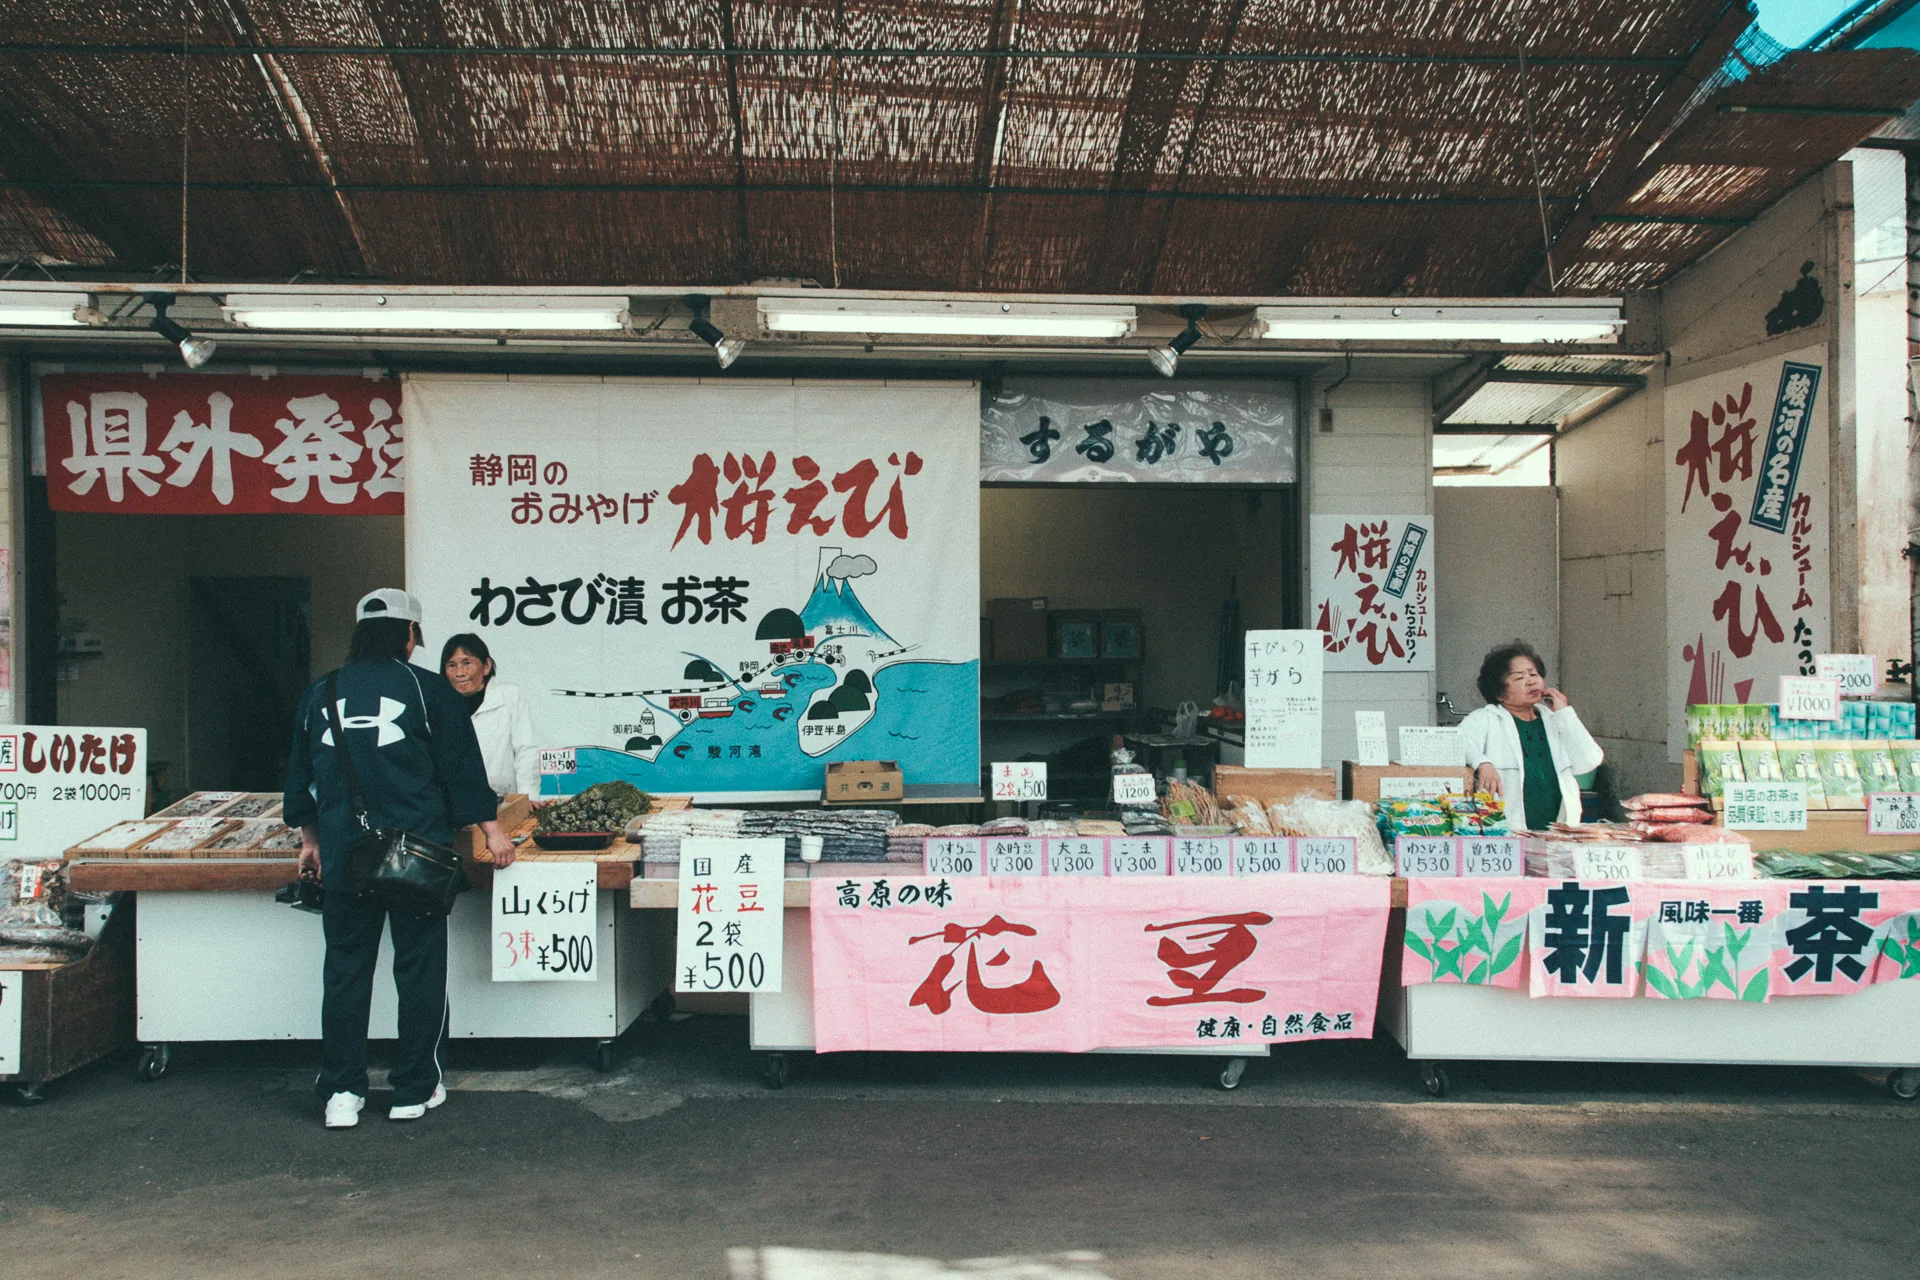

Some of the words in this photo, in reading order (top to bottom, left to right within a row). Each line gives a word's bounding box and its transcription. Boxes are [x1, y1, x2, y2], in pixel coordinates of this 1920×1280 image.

[1019, 416, 1234, 466] するがや
[1757, 373, 1811, 521] 駿河の名産
[469, 453, 568, 487] 静岡の
[510, 489, 660, 525] おみやげ
[667, 451, 924, 552] 桜えび
[1676, 382, 1784, 658] 桜えび
[470, 572, 648, 627] わさび漬
[661, 576, 750, 625] お茶
[1331, 520, 1406, 665] 桜えび
[1416, 568, 1428, 638] カルシューム
[825, 624, 858, 635] 富士川
[740, 661, 760, 672] 静岡
[802, 724, 846, 736] 伊豆半島
[22, 732, 137, 775] しいたけ
[707, 745, 761, 758] 駿河湾
[1734, 788, 1799, 802] 当店のお茶は
[1058, 842, 1091, 855] 大豆
[693, 853, 755, 876] 国産
[930, 857, 973, 873] ¥300
[991, 856, 1033, 872] ¥300
[1052, 856, 1094, 873] ¥300
[1115, 856, 1157, 873] ¥300
[1178, 857, 1222, 873] ¥500
[1237, 857, 1281, 873] ¥500
[1301, 858, 1346, 873] ¥500
[501, 879, 595, 915] 山くらげ
[691, 883, 765, 915] 花豆
[836, 879, 954, 908] 高原の味
[1658, 900, 1764, 924] 風味一番
[696, 920, 744, 947] 2袋
[1542, 881, 1630, 985] 新
[1784, 885, 1879, 983] 茶
[537, 933, 593, 973] ¥500
[908, 912, 1274, 1015] 花豆
[683, 952, 765, 989] ¥500
